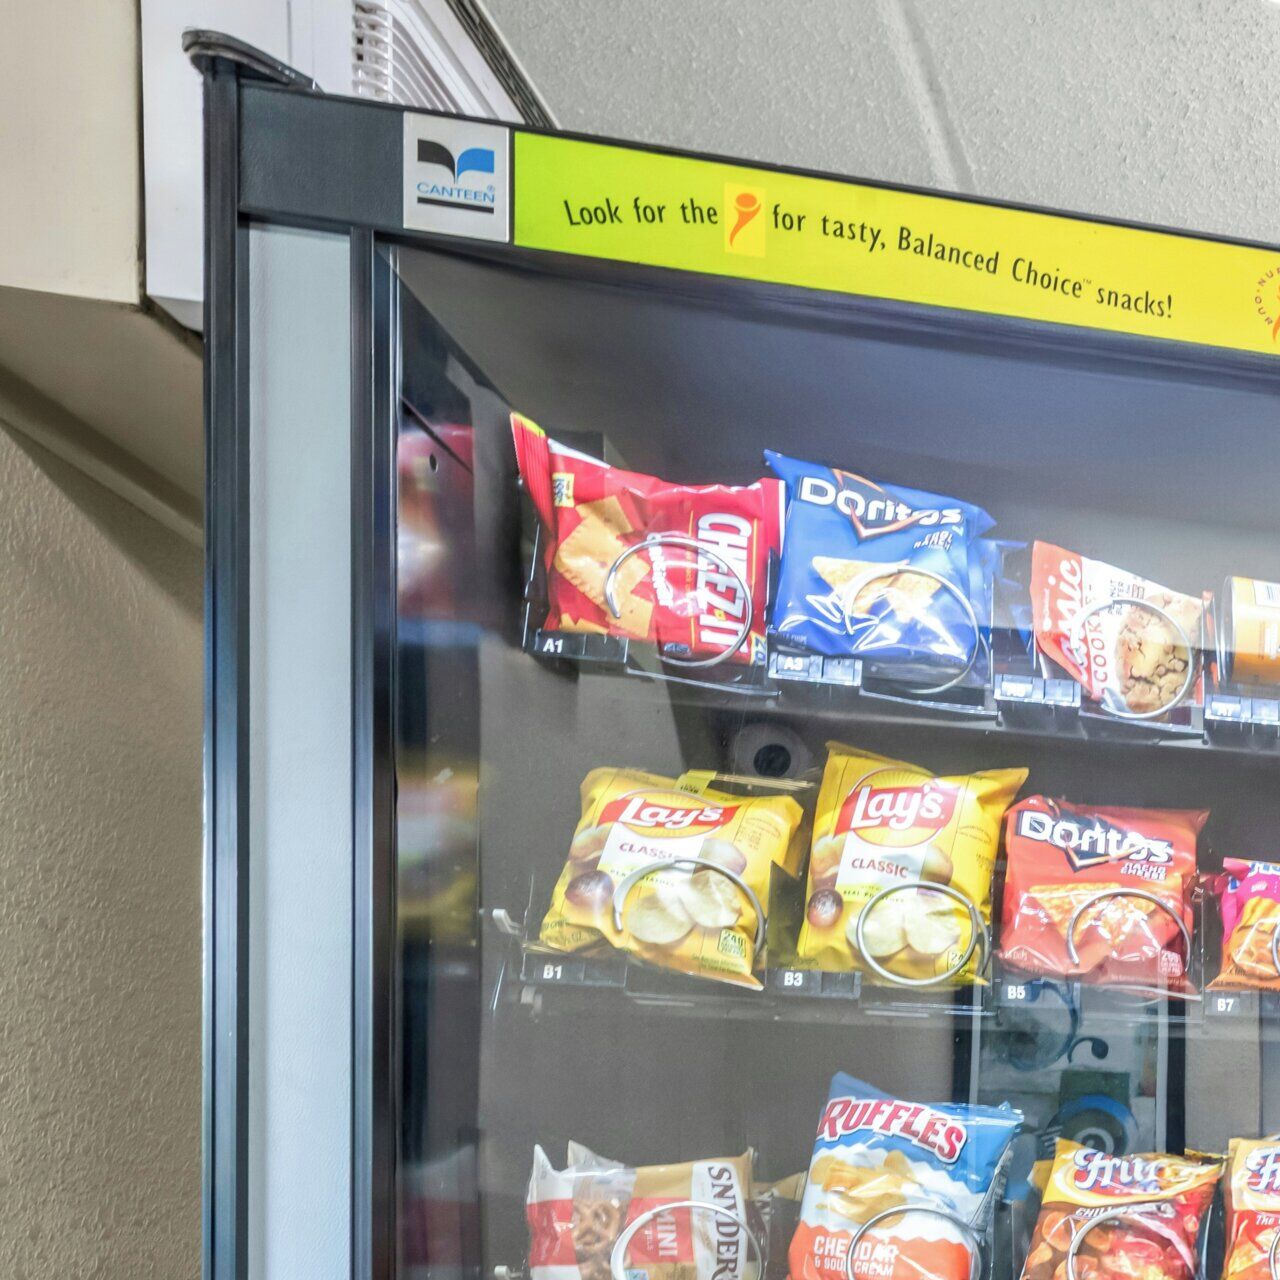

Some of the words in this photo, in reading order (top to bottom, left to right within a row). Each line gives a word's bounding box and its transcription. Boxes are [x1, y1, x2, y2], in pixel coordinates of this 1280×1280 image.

[417, 181, 495, 204] CANTEEN
[564, 197, 623, 226] Look
[632, 197, 667, 226] for
[680, 198, 718, 226] the
[772, 203, 806, 231] for
[821, 215, 887, 252] tasty,
[898, 227, 999, 276] Balanced
[1095, 285, 1173, 318] snacks!
[799, 475, 965, 526] Doritos
[541, 637, 564, 654] A1
[617, 797, 724, 829] Lay's
[849, 783, 946, 830] Lay's
[1019, 810, 1175, 863] Doritos
[851, 857, 910, 879] CLASSIC
[543, 965, 563, 980] B1
[784, 971, 803, 986] B3
[1007, 985, 1026, 1000] B5
[1217, 998, 1235, 1012] B7
[816, 1097, 965, 1162] RUFFLES
